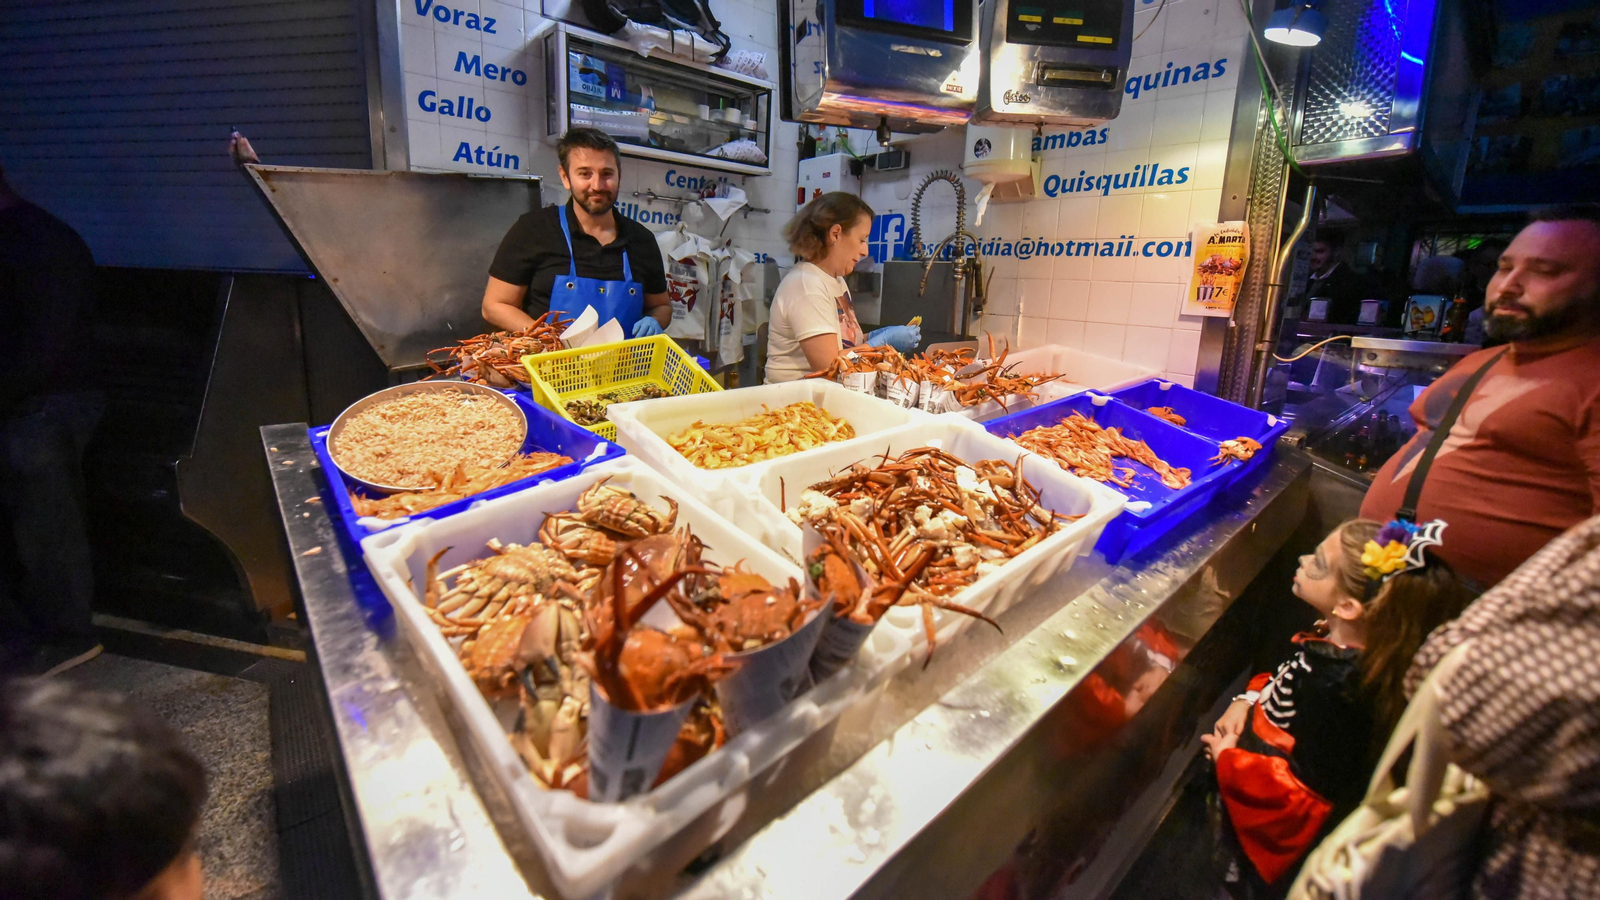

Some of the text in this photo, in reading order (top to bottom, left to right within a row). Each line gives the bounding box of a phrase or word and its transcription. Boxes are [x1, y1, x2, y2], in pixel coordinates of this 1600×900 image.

[413, 0, 497, 35] Voraz
[453, 51, 527, 86] Mero
[1124, 58, 1228, 100] quinas
[418, 89, 492, 123] Gallo
[453, 141, 520, 171] Atún
[1031, 127, 1110, 152] ambas
[1043, 163, 1190, 198] Quisquillas
[614, 201, 682, 225] illones
